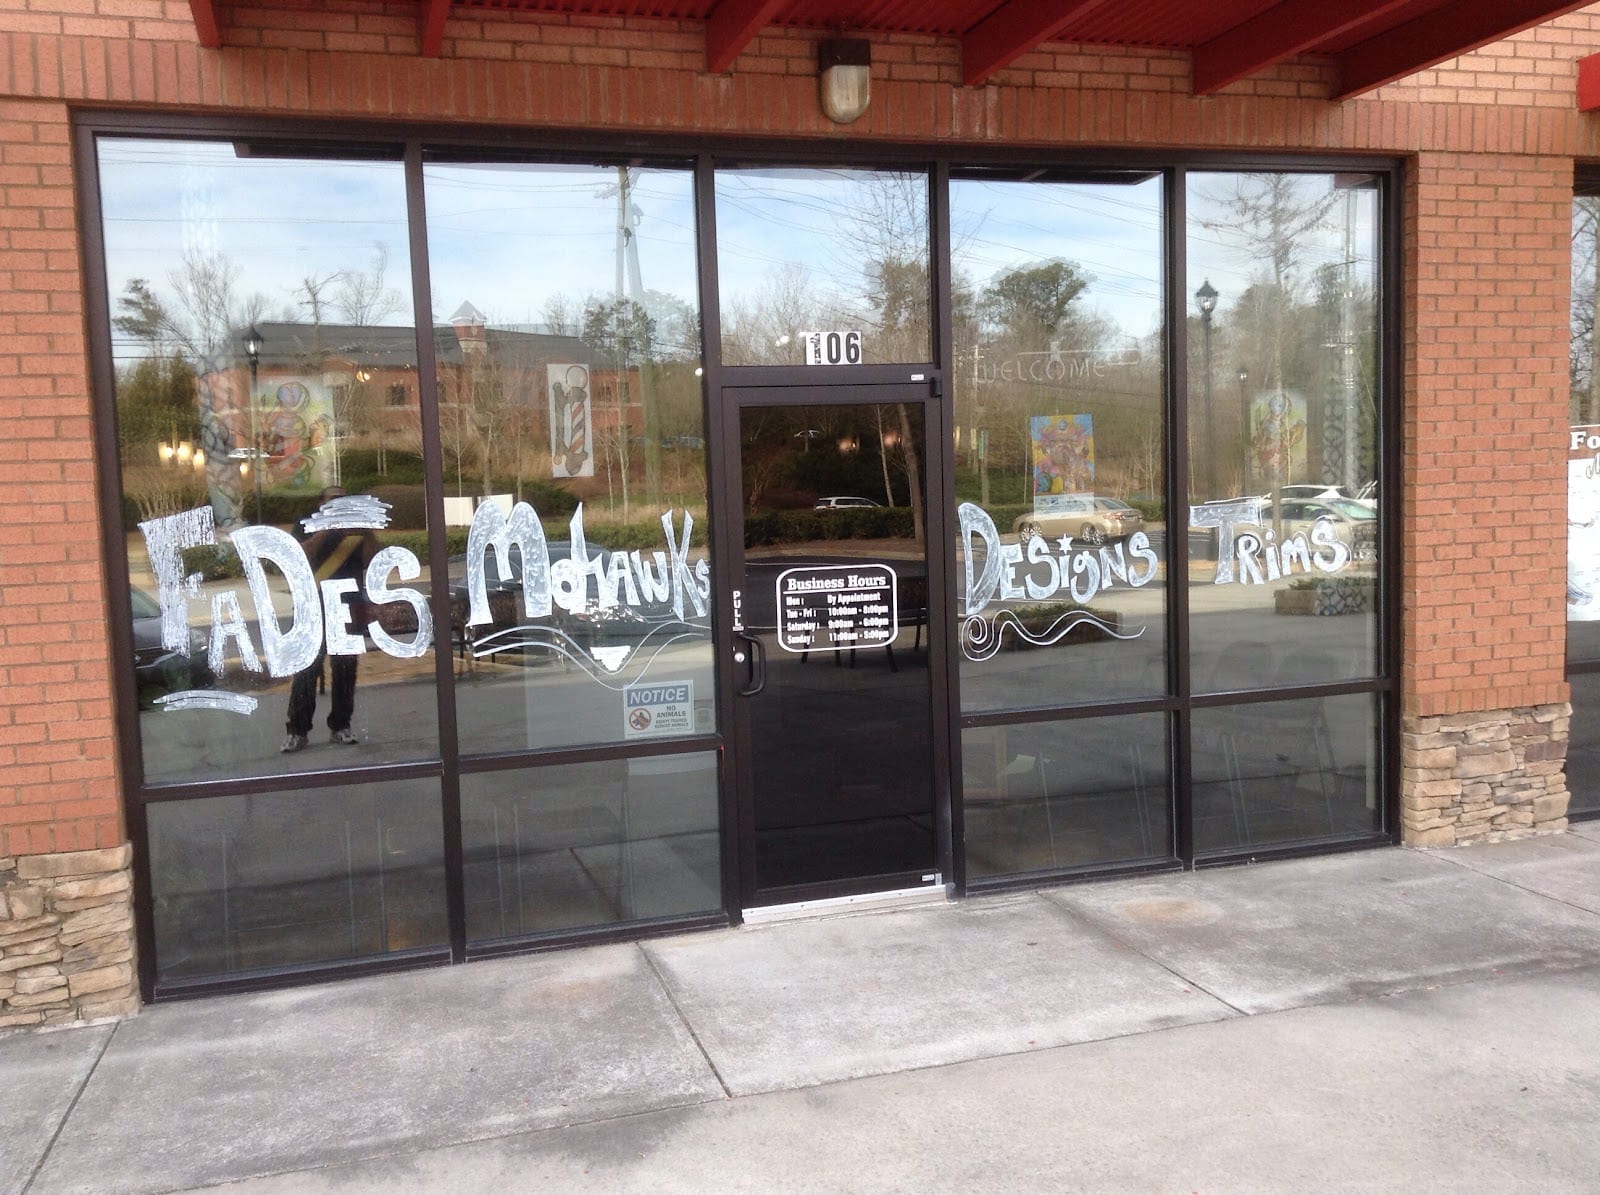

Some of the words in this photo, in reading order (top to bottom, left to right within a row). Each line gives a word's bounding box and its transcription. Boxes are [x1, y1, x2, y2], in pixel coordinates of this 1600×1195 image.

[810, 332, 860, 364] 106
[787, 577, 845, 591] Business
[847, 575, 886, 588] Hours
[786, 596, 800, 606] Mon
[827, 594, 837, 606] By
[838, 592, 881, 605] Appointment
[732, 590, 742, 627] PULL
[786, 609, 798, 618] Tue
[803, 608, 812, 618] Fri
[787, 621, 816, 632] Saturday
[787, 634, 811, 645] Sunday
[630, 687, 686, 705] NOTICE
